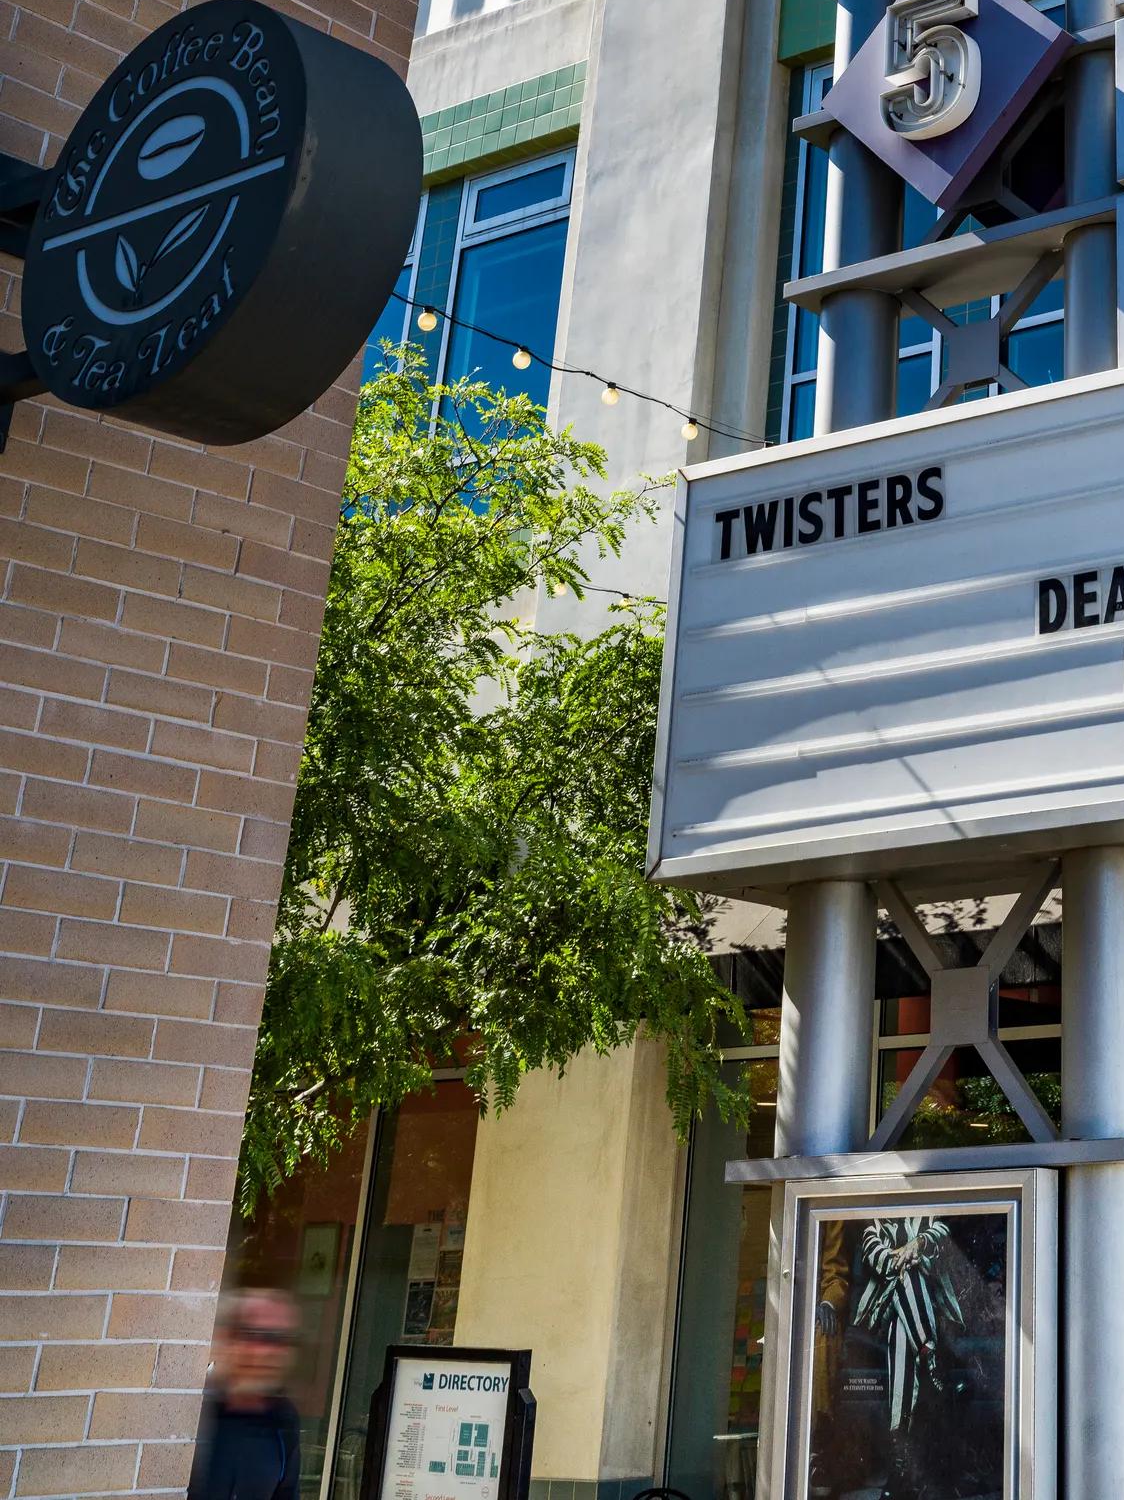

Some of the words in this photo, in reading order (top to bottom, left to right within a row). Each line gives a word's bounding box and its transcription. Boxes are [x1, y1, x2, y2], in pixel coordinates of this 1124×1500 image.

[108, 22, 225, 123] Coffee
[229, 19, 281, 155] Bean
[41, 315, 77, 367] &
[72, 334, 127, 392] Tea
[138, 245, 236, 376] Leaf
[715, 466, 945, 560] TWISTERS
[439, 1373, 510, 1393] DIRECTORY
